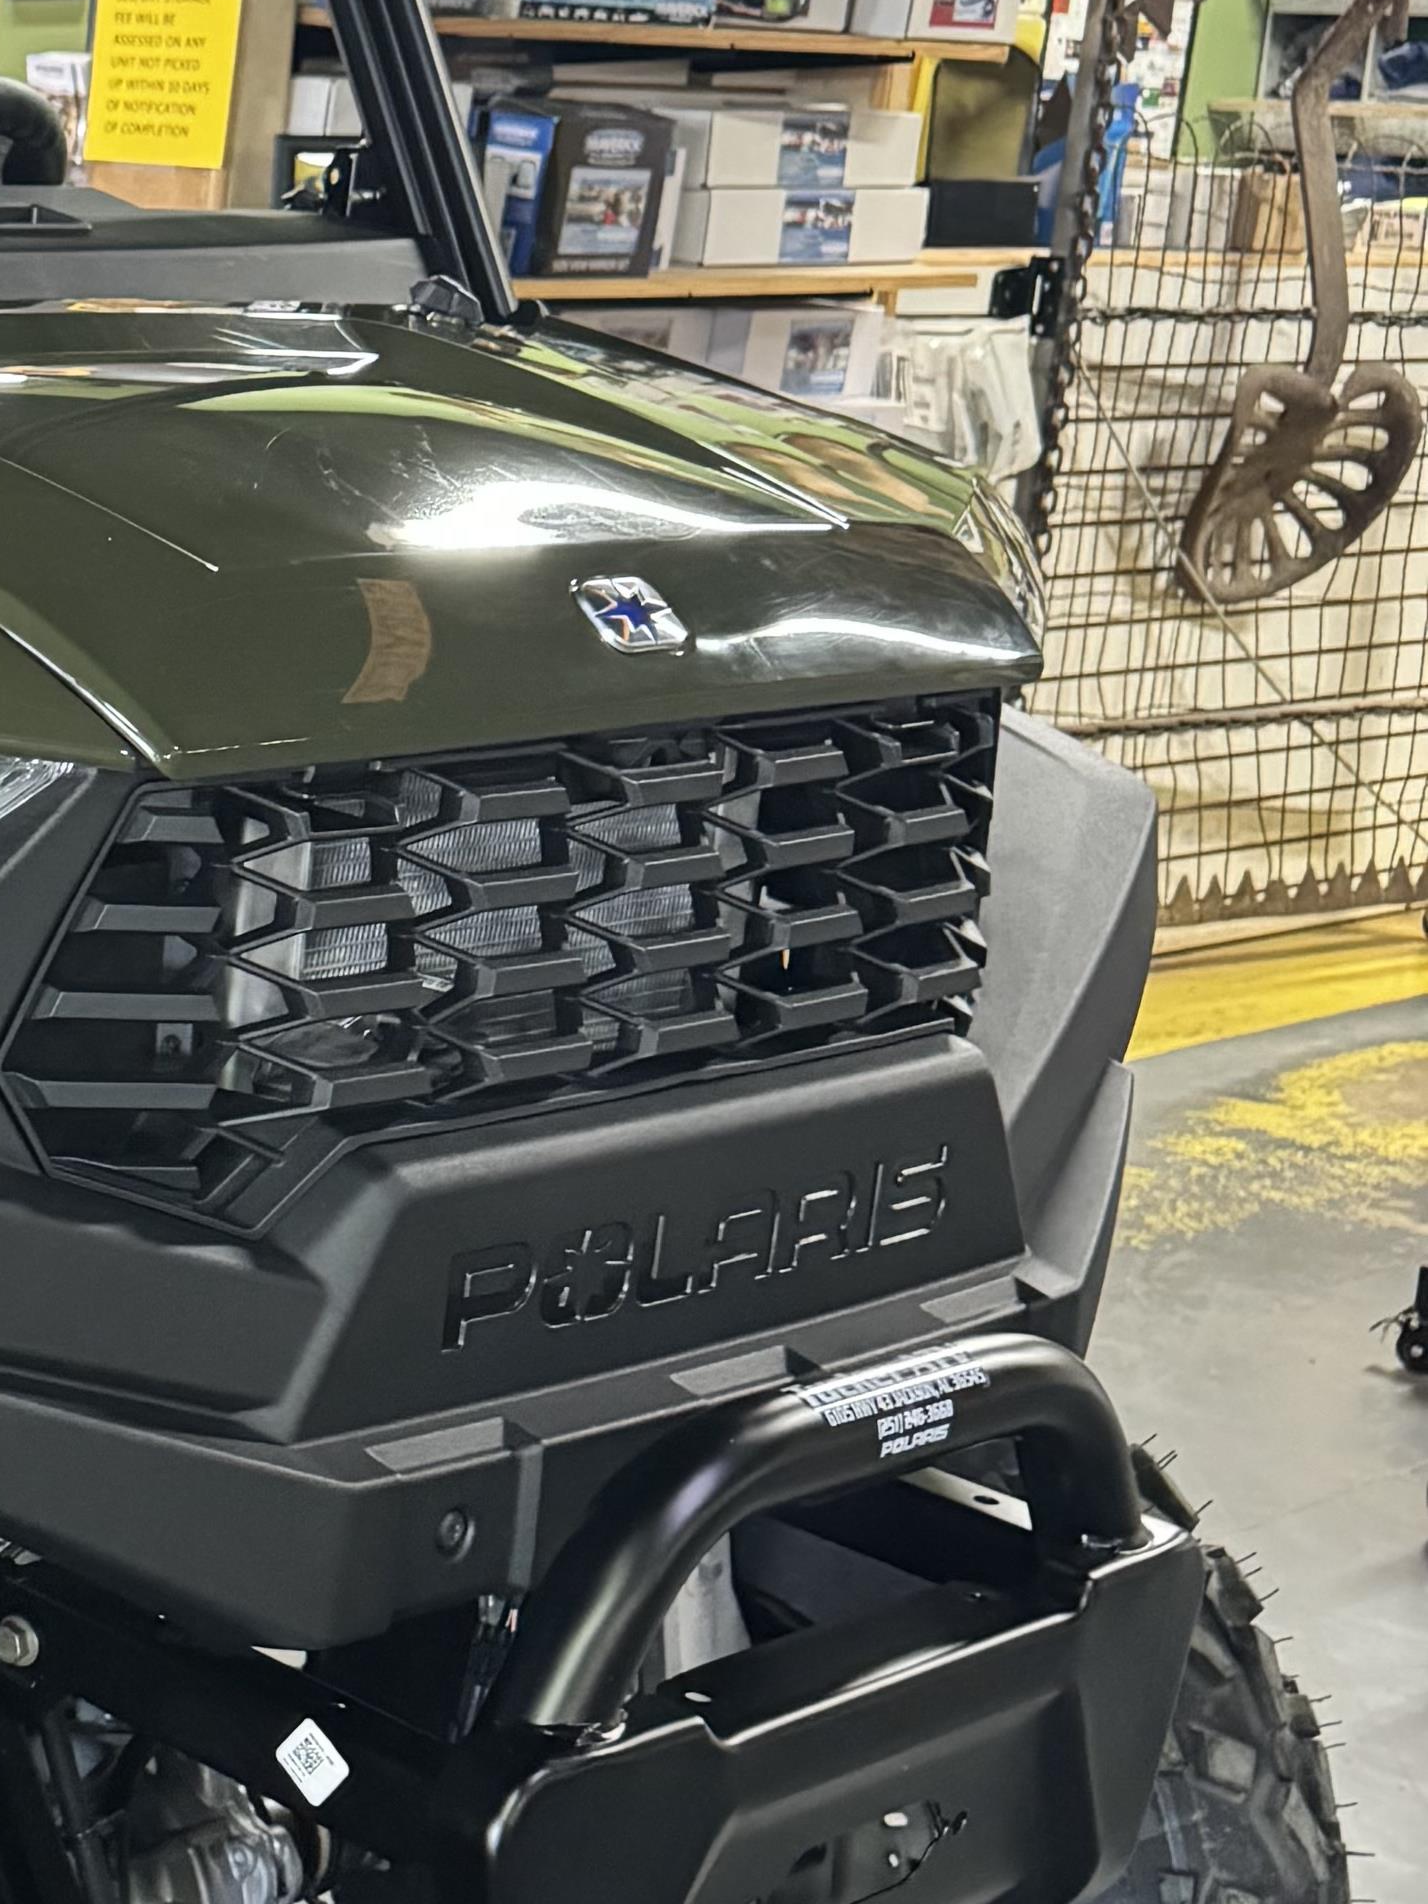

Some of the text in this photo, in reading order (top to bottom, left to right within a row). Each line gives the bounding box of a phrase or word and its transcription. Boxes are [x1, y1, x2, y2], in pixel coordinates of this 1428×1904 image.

[137, 56, 161, 70] NOT
[123, 100, 197, 116] NOTIFICATION
[120, 122, 190, 138] COMPLETION
[442, 1143, 948, 1353] POLARIS
[880, 1424, 951, 1459] POLARIS
